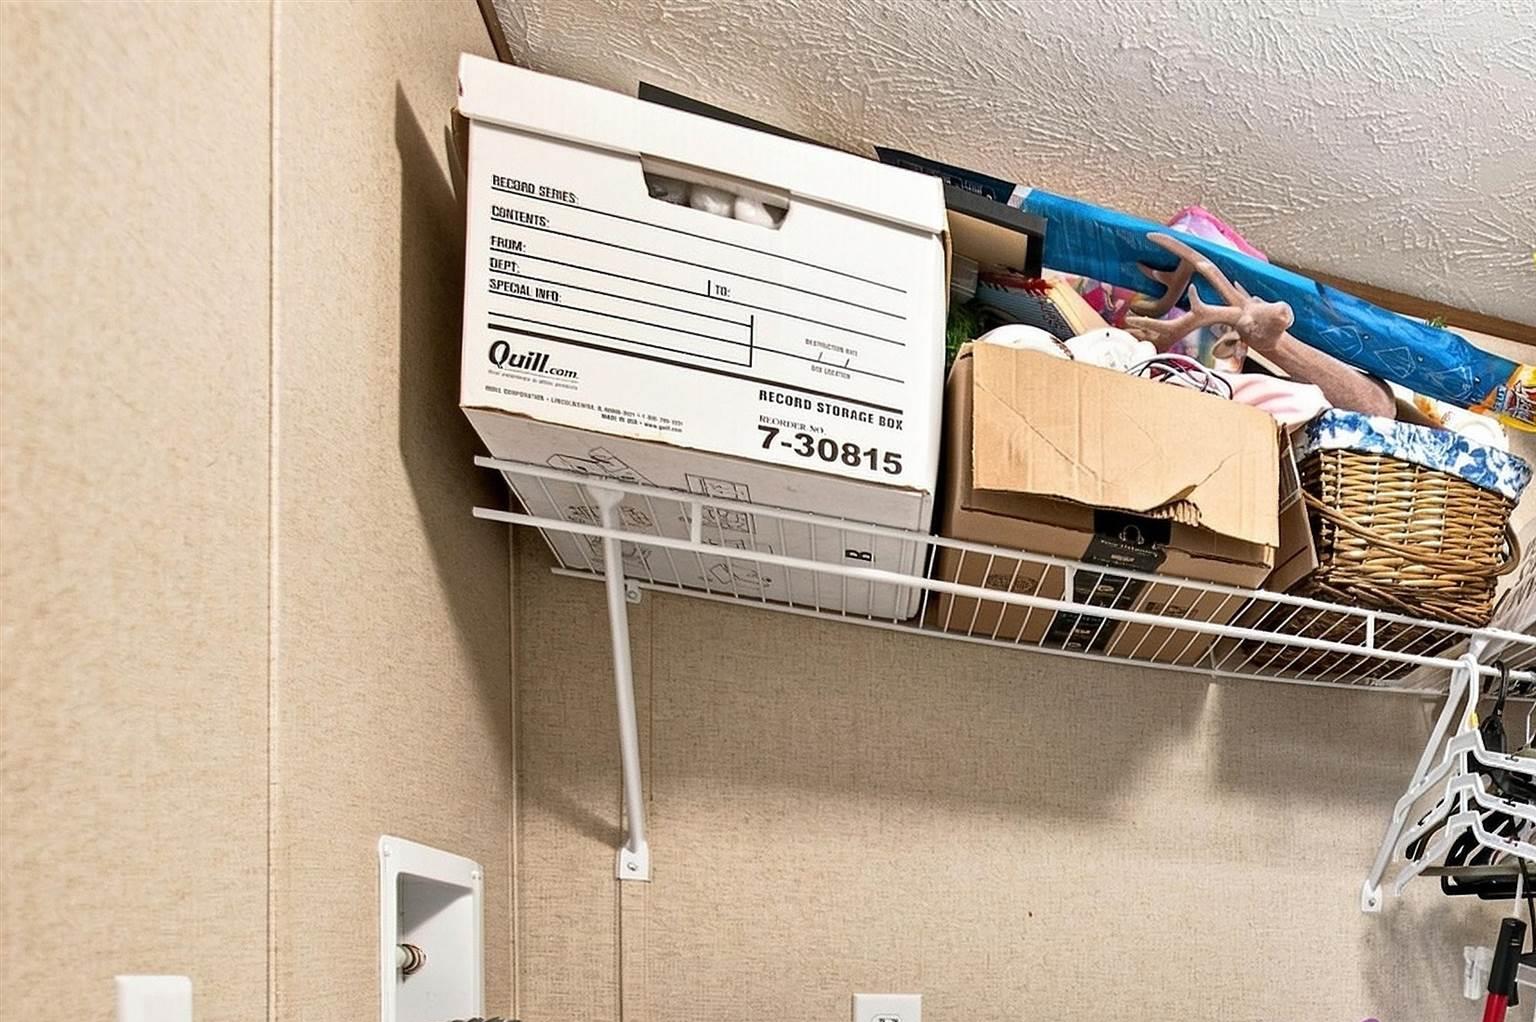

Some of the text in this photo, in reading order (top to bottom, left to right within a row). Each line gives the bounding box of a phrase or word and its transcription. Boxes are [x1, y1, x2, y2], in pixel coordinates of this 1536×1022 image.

[492, 174, 580, 205] RECORD SERIES:
[491, 205, 551, 228] CONTENTS:
[490, 235, 527, 253] FROM:
[489, 257, 521, 274] DEPT:
[488, 278, 563, 304] SPECIAL INFO:
[714, 284, 732, 298] TO:
[759, 389, 904, 431] RECORD STORAGE BOX
[759, 414, 827, 436] REORDER NO.
[757, 424, 903, 476] 7-30815
